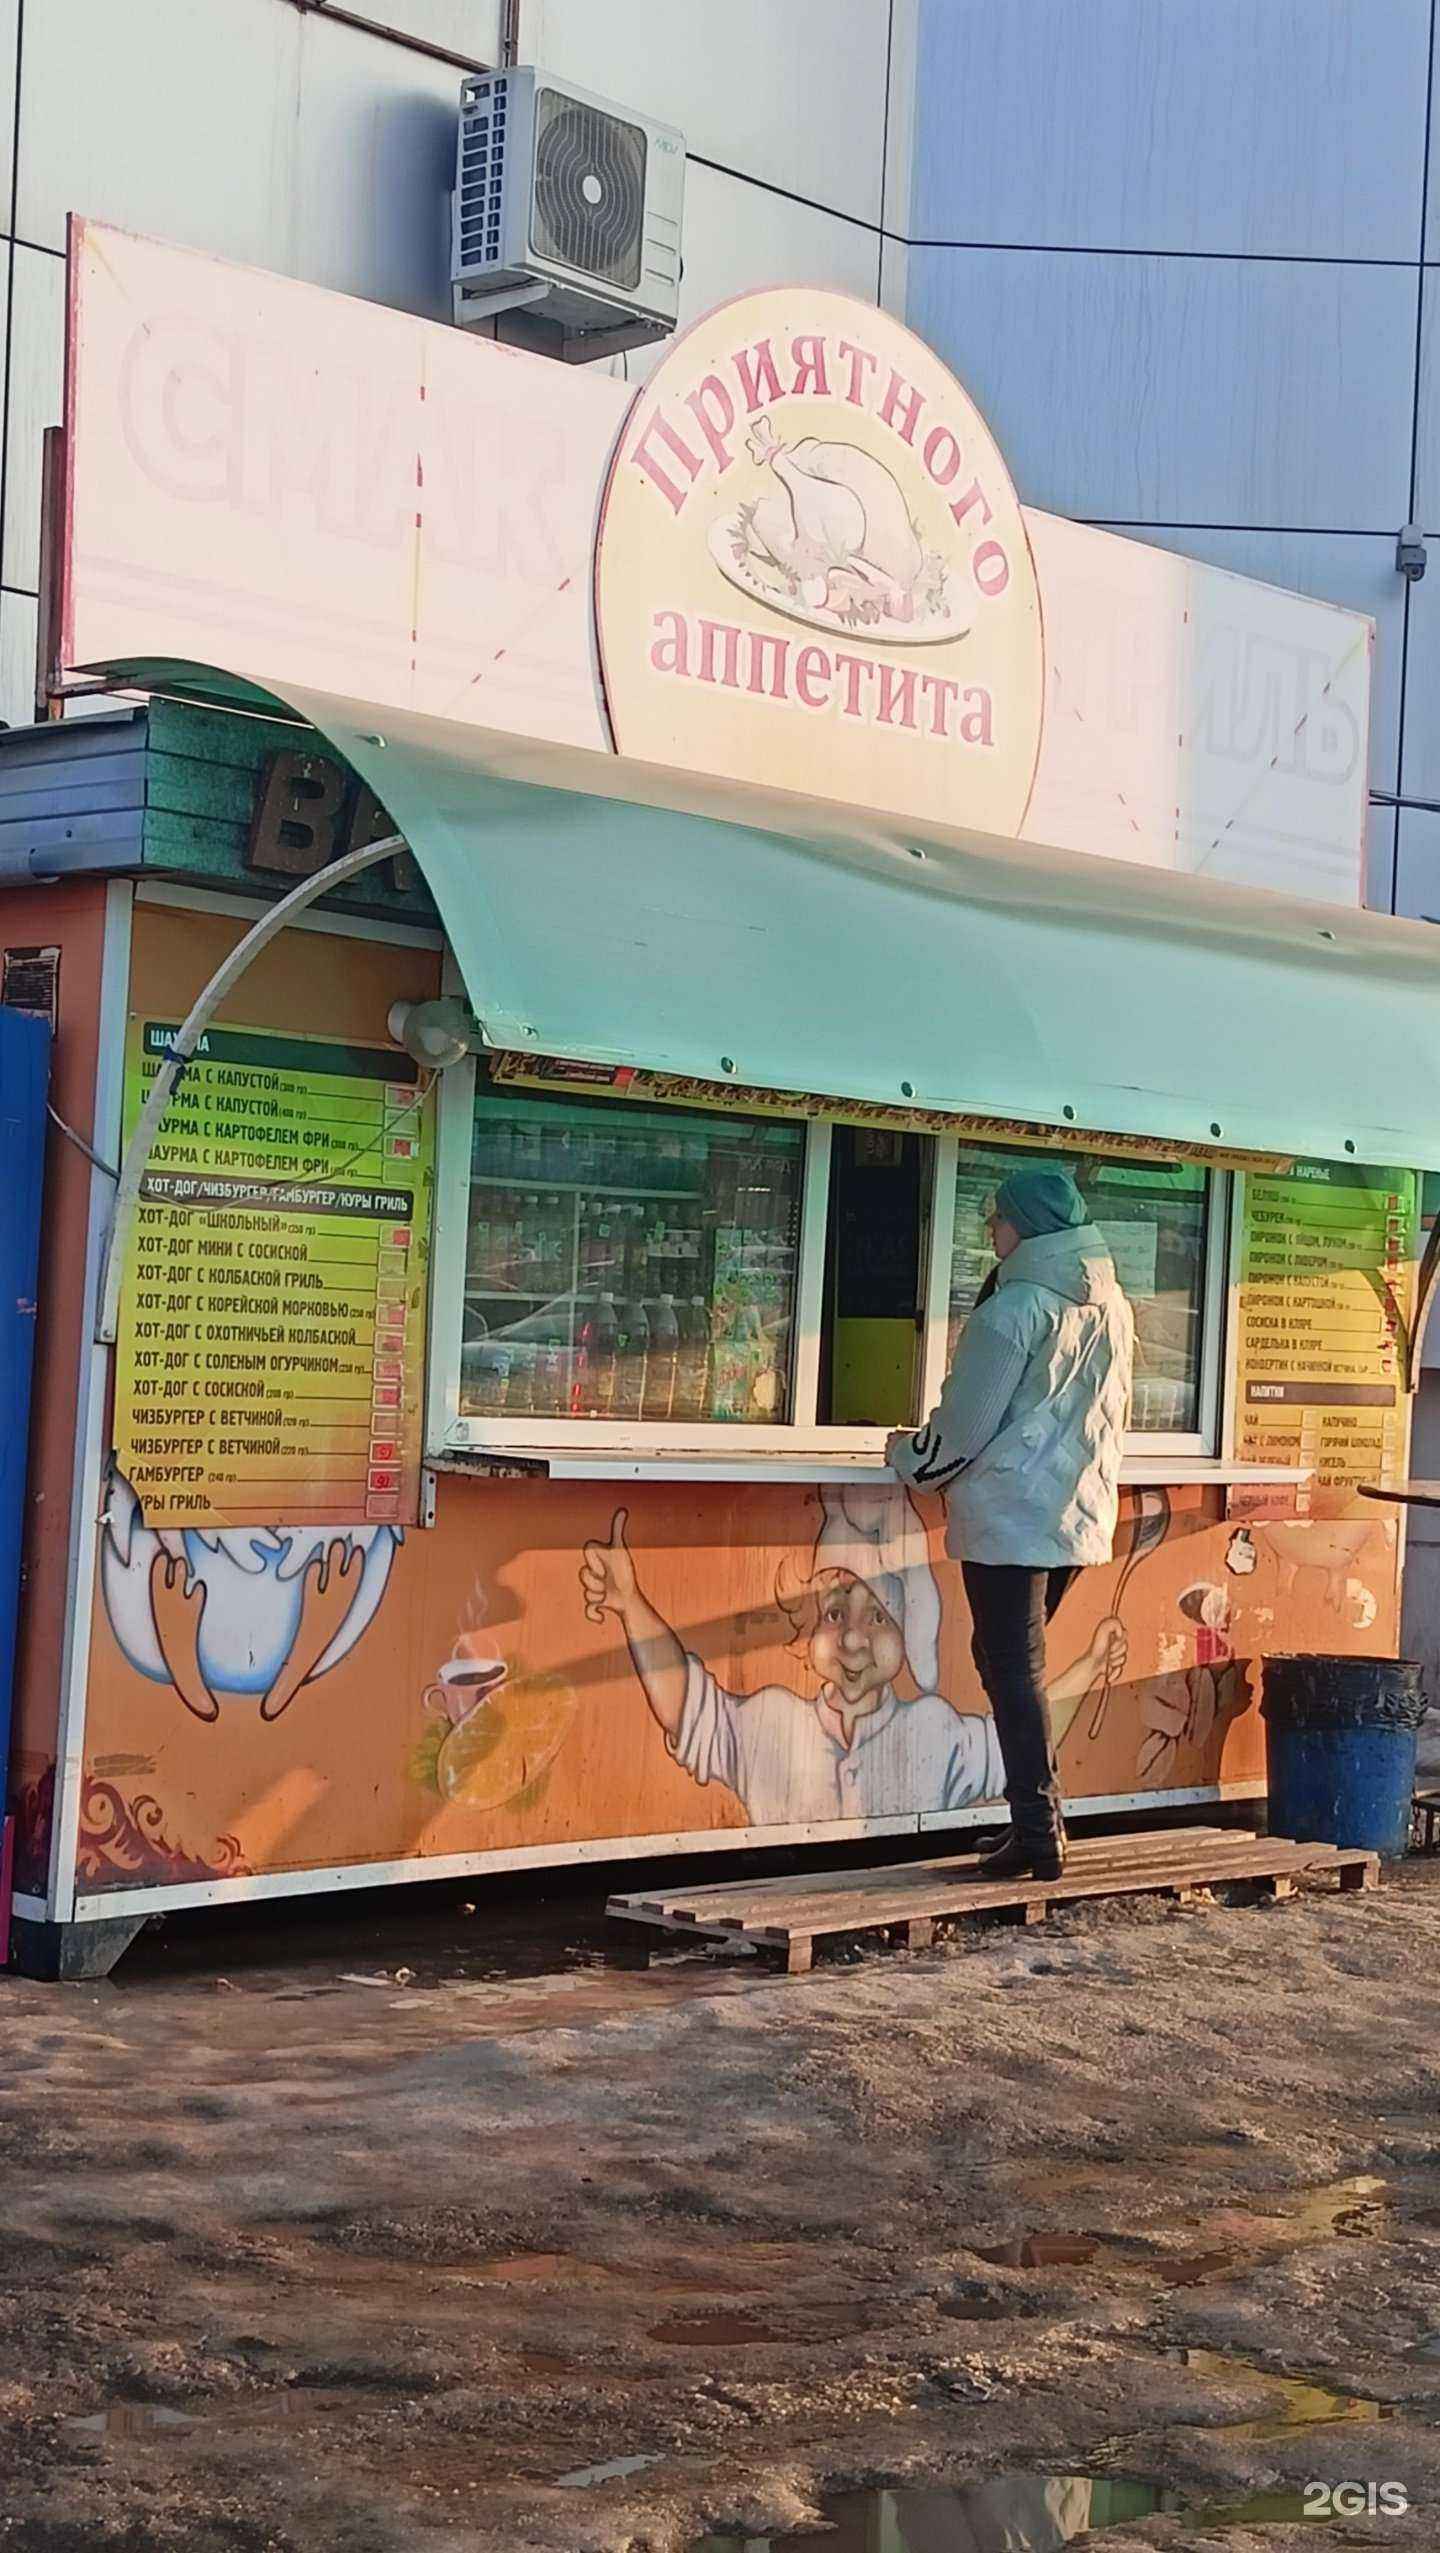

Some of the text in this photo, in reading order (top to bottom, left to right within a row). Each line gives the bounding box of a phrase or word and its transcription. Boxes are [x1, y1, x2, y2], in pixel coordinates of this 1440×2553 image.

[650, 609, 996, 747] аппетита
[206, 1068, 213, 1084] С
[218, 1070, 279, 1090] КАПУСТОЙ
[205, 1094, 212, 1110] С
[216, 1097, 278, 1117] КАПУСТОЙ
[204, 1121, 211, 1137] С
[215, 1122, 299, 1145] КАРТОФЕЛЕМ
[303, 1130, 330, 1148] ФРИ
[148, 1144, 197, 1163] АУРМА
[203, 1149, 210, 1164] С
[214, 1150, 298, 1172] КАРТОФЕЛЕМ
[302, 1158, 329, 1174] ФРИ
[375, 1195, 408, 1212] ГРИЛЬ
[138, 1207, 194, 1228] ХОТ-ДОГ
[138, 1236, 308, 1261] ХОТ-ДОГ МИНИ С СОСИСКОЙ
[137, 1264, 324, 1289] ХОТ-ДОГ С КОЛБАСКОЙ ГРИЛЬ
[136, 1293, 192, 1313] ХОТ-ДОГ
[196, 1296, 203, 1311] С
[208, 1294, 278, 1315] КОРЕЙСКОЙ
[282, 1300, 349, 1318] МОРКОВЬЮ
[135, 1322, 356, 1345] ХОТ-ДОГ С ОХОТНИЧЬЕЙ КОЛБАСКОЙ
[134, 1351, 189, 1370] ХОТ-ДОГ
[194, 1353, 201, 1369] С
[206, 1353, 266, 1370] СОЛЕНЫМ
[270, 1355, 339, 1373] ОГУРЧИКОМ
[133, 1379, 188, 1399] ХОТ-ДОГ
[193, 1381, 200, 1396] С
[205, 1380, 265, 1398] СОСИСКОЙ
[132, 1408, 205, 1425] ЧИЗБУРГЕР
[209, 1410, 216, 1425] С
[221, 1408, 282, 1427] ВЕТЧИНОЙ
[131, 1438, 203, 1455] ЧИЗБУРГЕР
[208, 1438, 215, 1455] С
[219, 1437, 280, 1455] ВЕТЧИНОЙ
[128, 1466, 204, 1482] ГАМБУРГЕР
[170, 1494, 211, 1510] ГРИЛЬ
